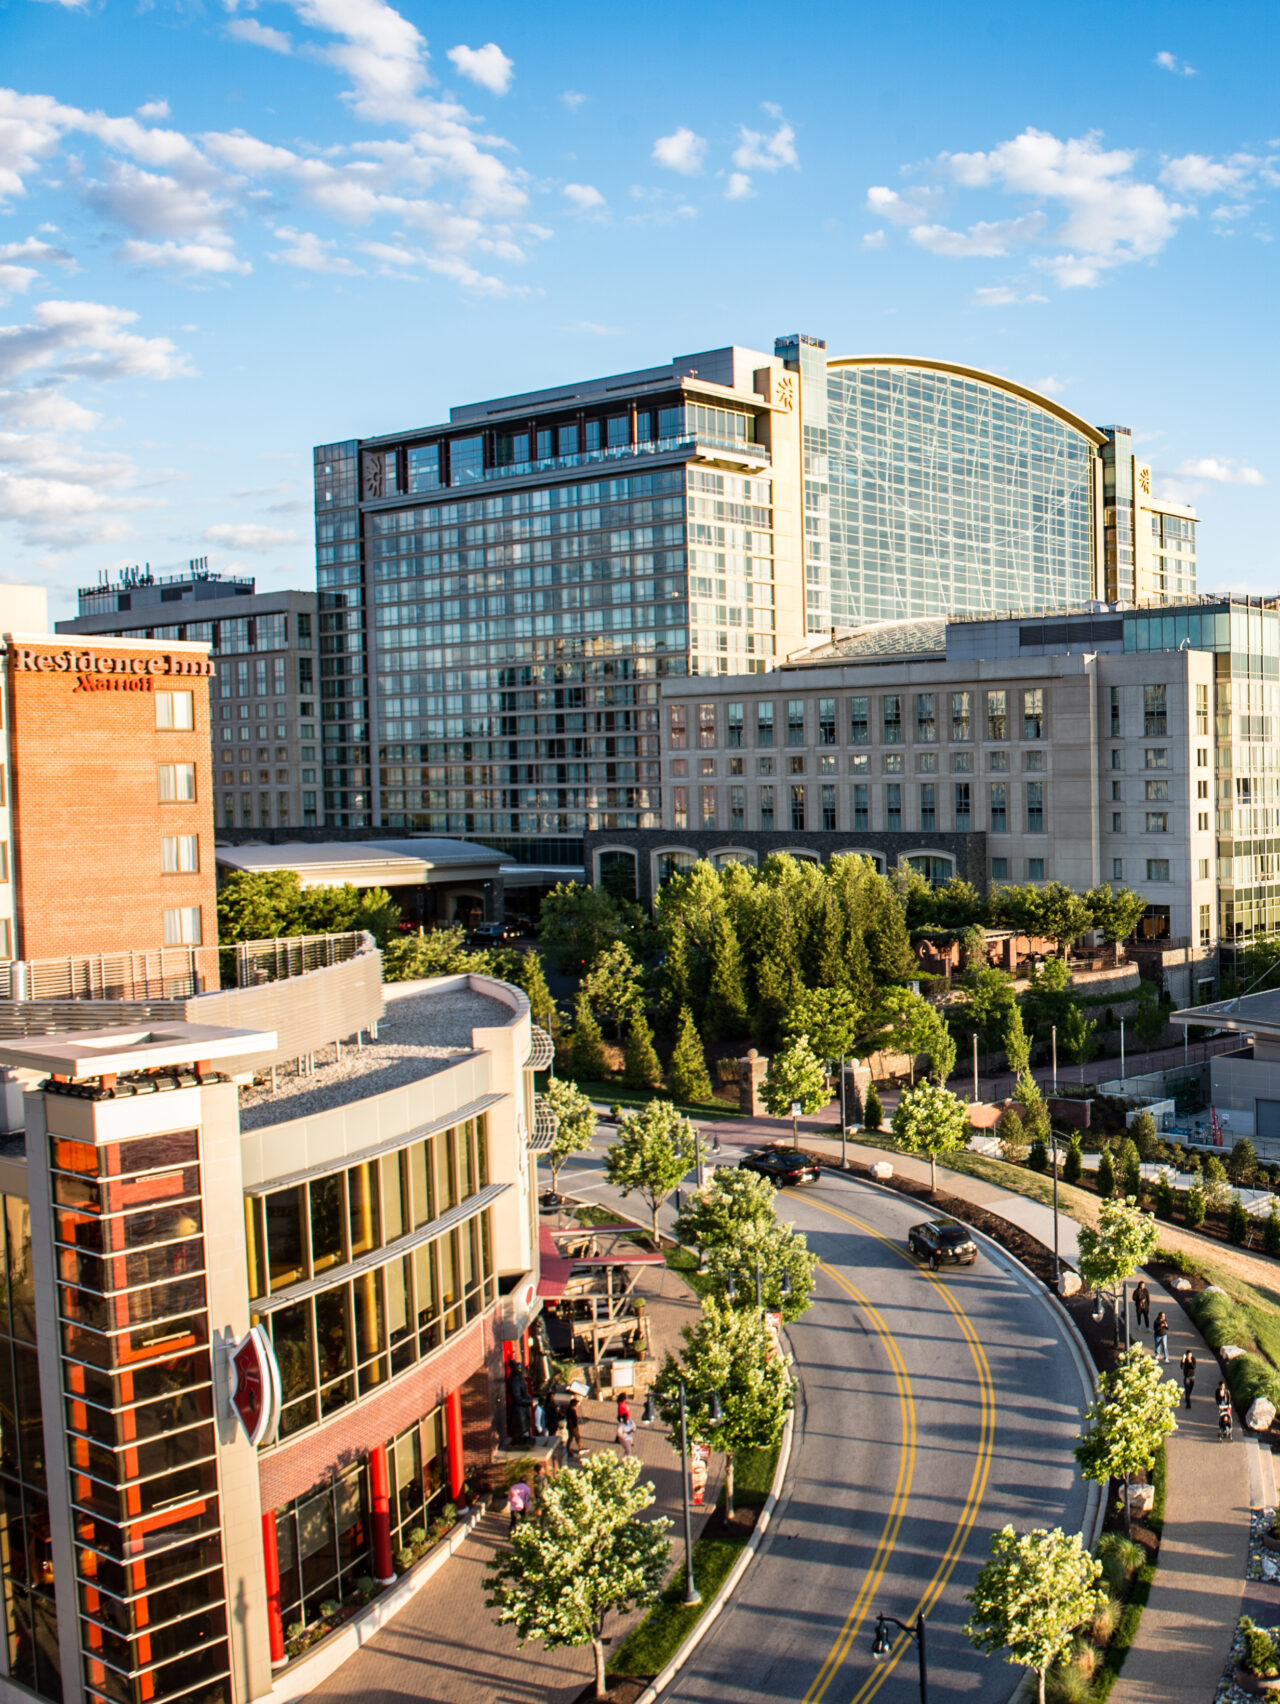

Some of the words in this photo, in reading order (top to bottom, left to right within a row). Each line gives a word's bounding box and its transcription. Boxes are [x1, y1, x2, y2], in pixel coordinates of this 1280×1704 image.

[15, 648, 163, 674] Residence
[169, 655, 216, 677] Inn
[74, 675, 154, 693] Marriott
